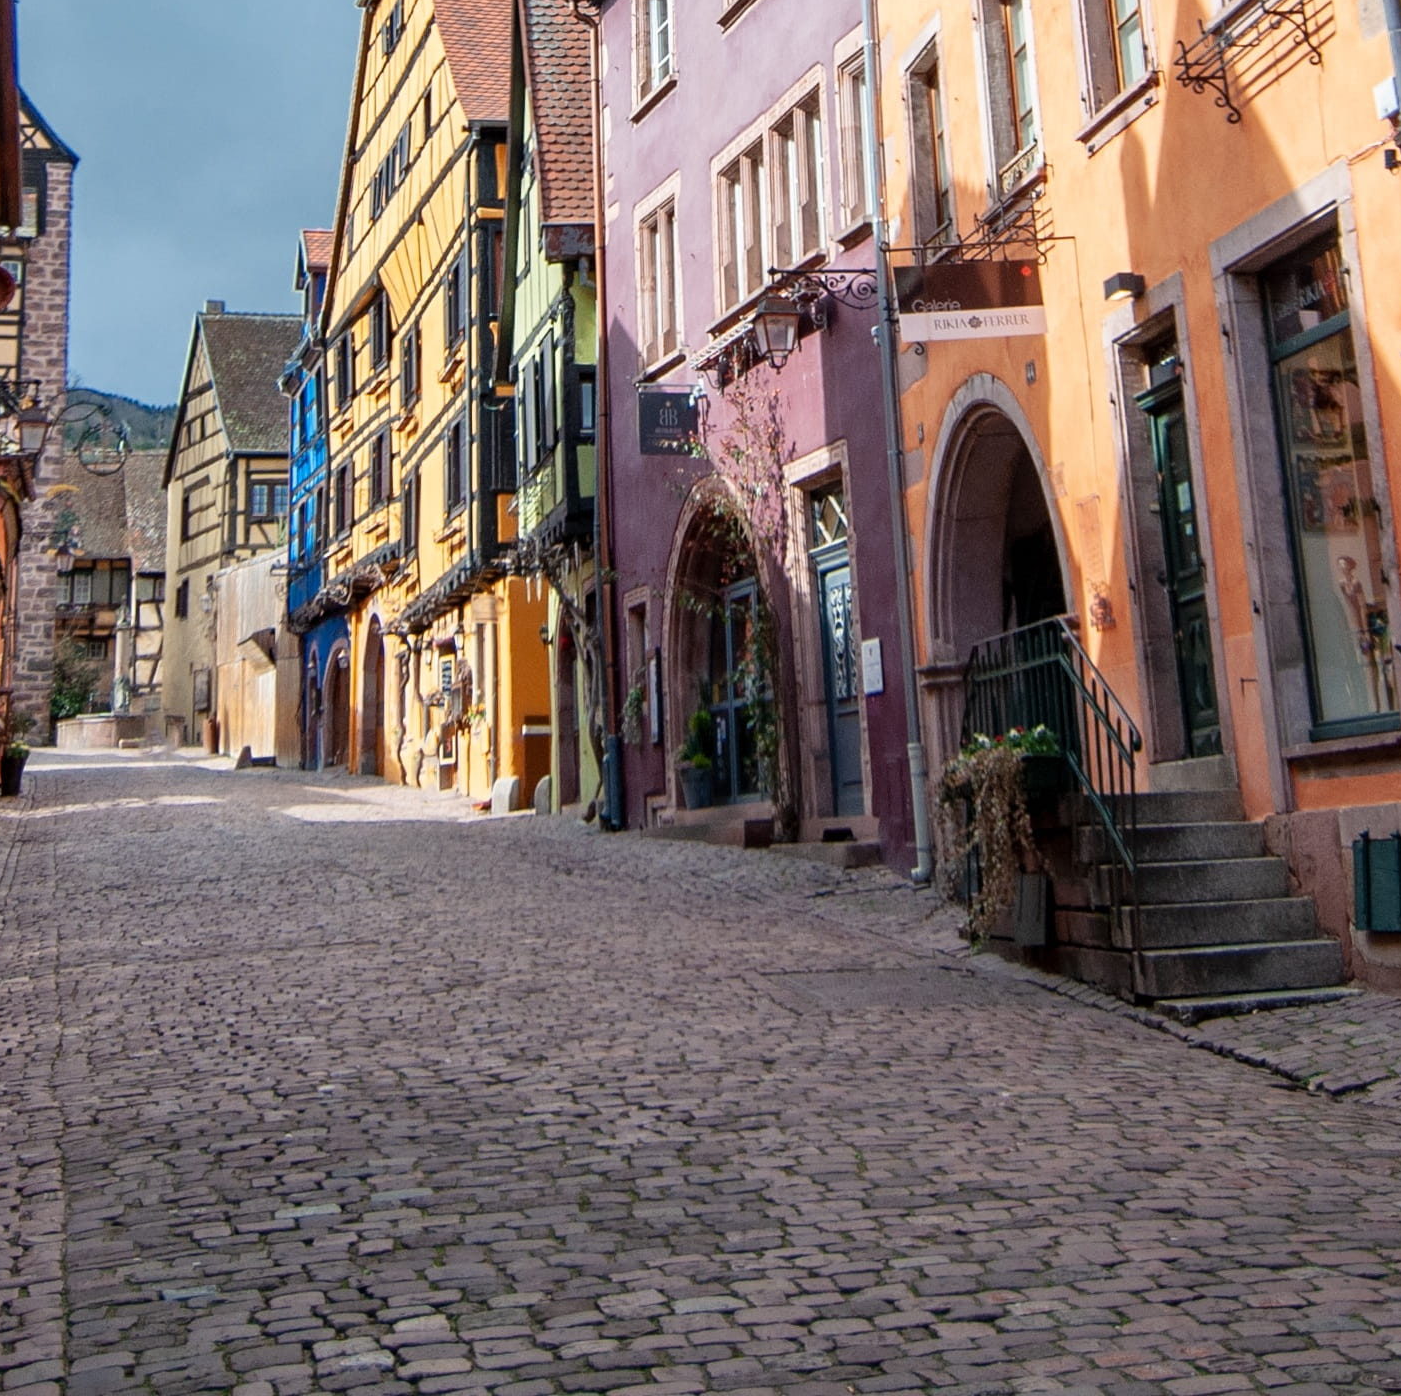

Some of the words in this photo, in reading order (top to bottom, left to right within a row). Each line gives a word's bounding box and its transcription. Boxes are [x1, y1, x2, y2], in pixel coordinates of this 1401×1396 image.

[911, 299, 961, 314] Galerie
[933, 319, 968, 331] RIKIA
[983, 314, 1030, 328] FERRER
